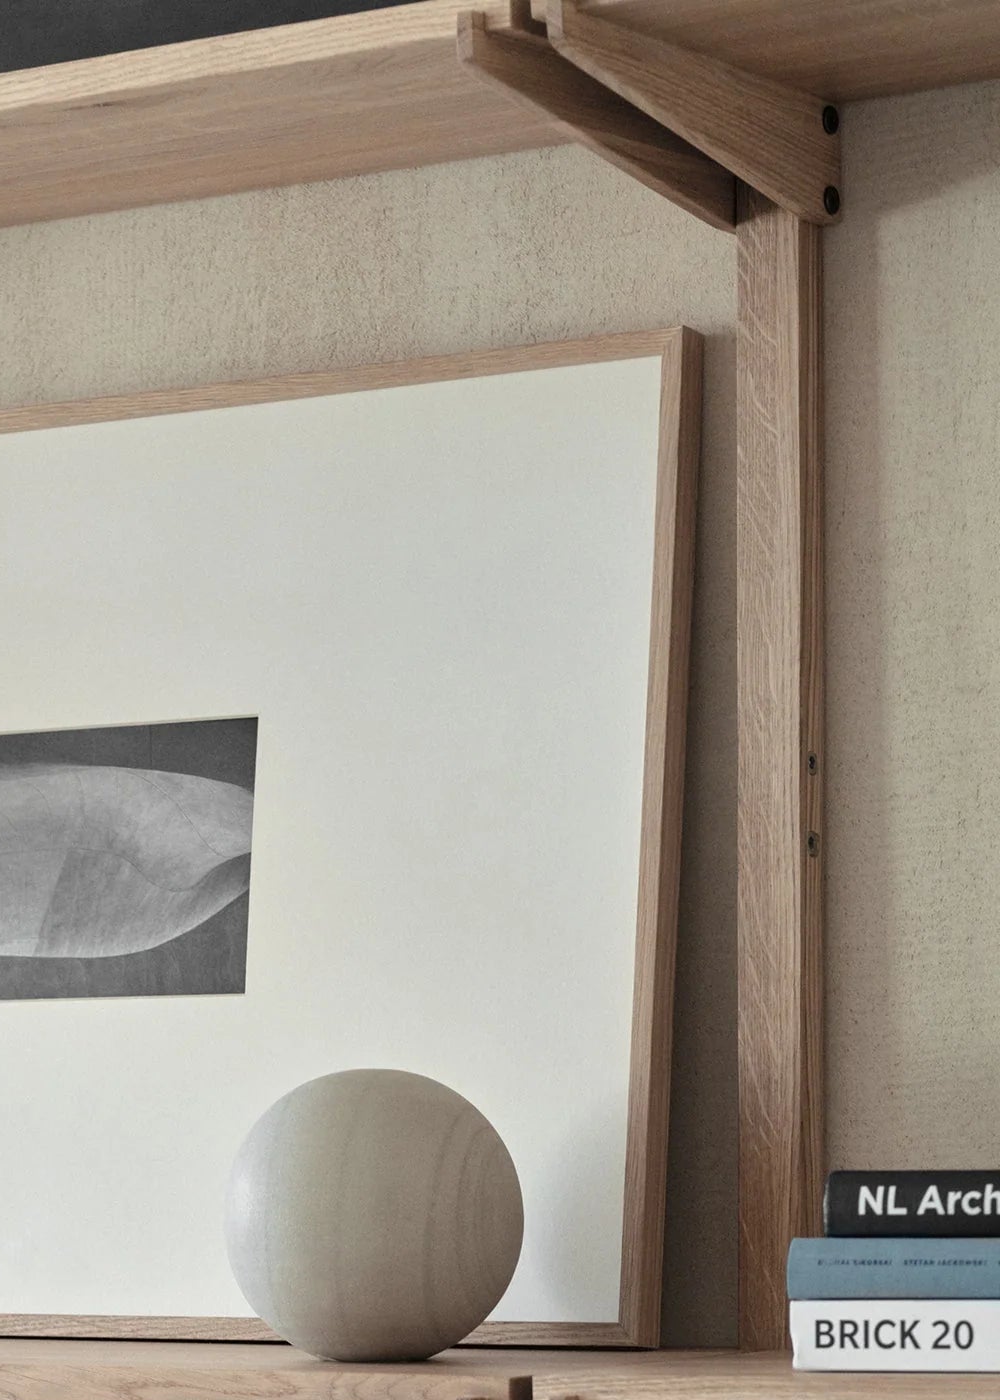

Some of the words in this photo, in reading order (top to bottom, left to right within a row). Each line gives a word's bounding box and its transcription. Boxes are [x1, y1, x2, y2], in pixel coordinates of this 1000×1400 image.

[857, 1184, 908, 1216] NL
[916, 1183, 1000, 1216] Arch
[814, 1319, 922, 1350] BRICK
[931, 1319, 974, 1350] 20
